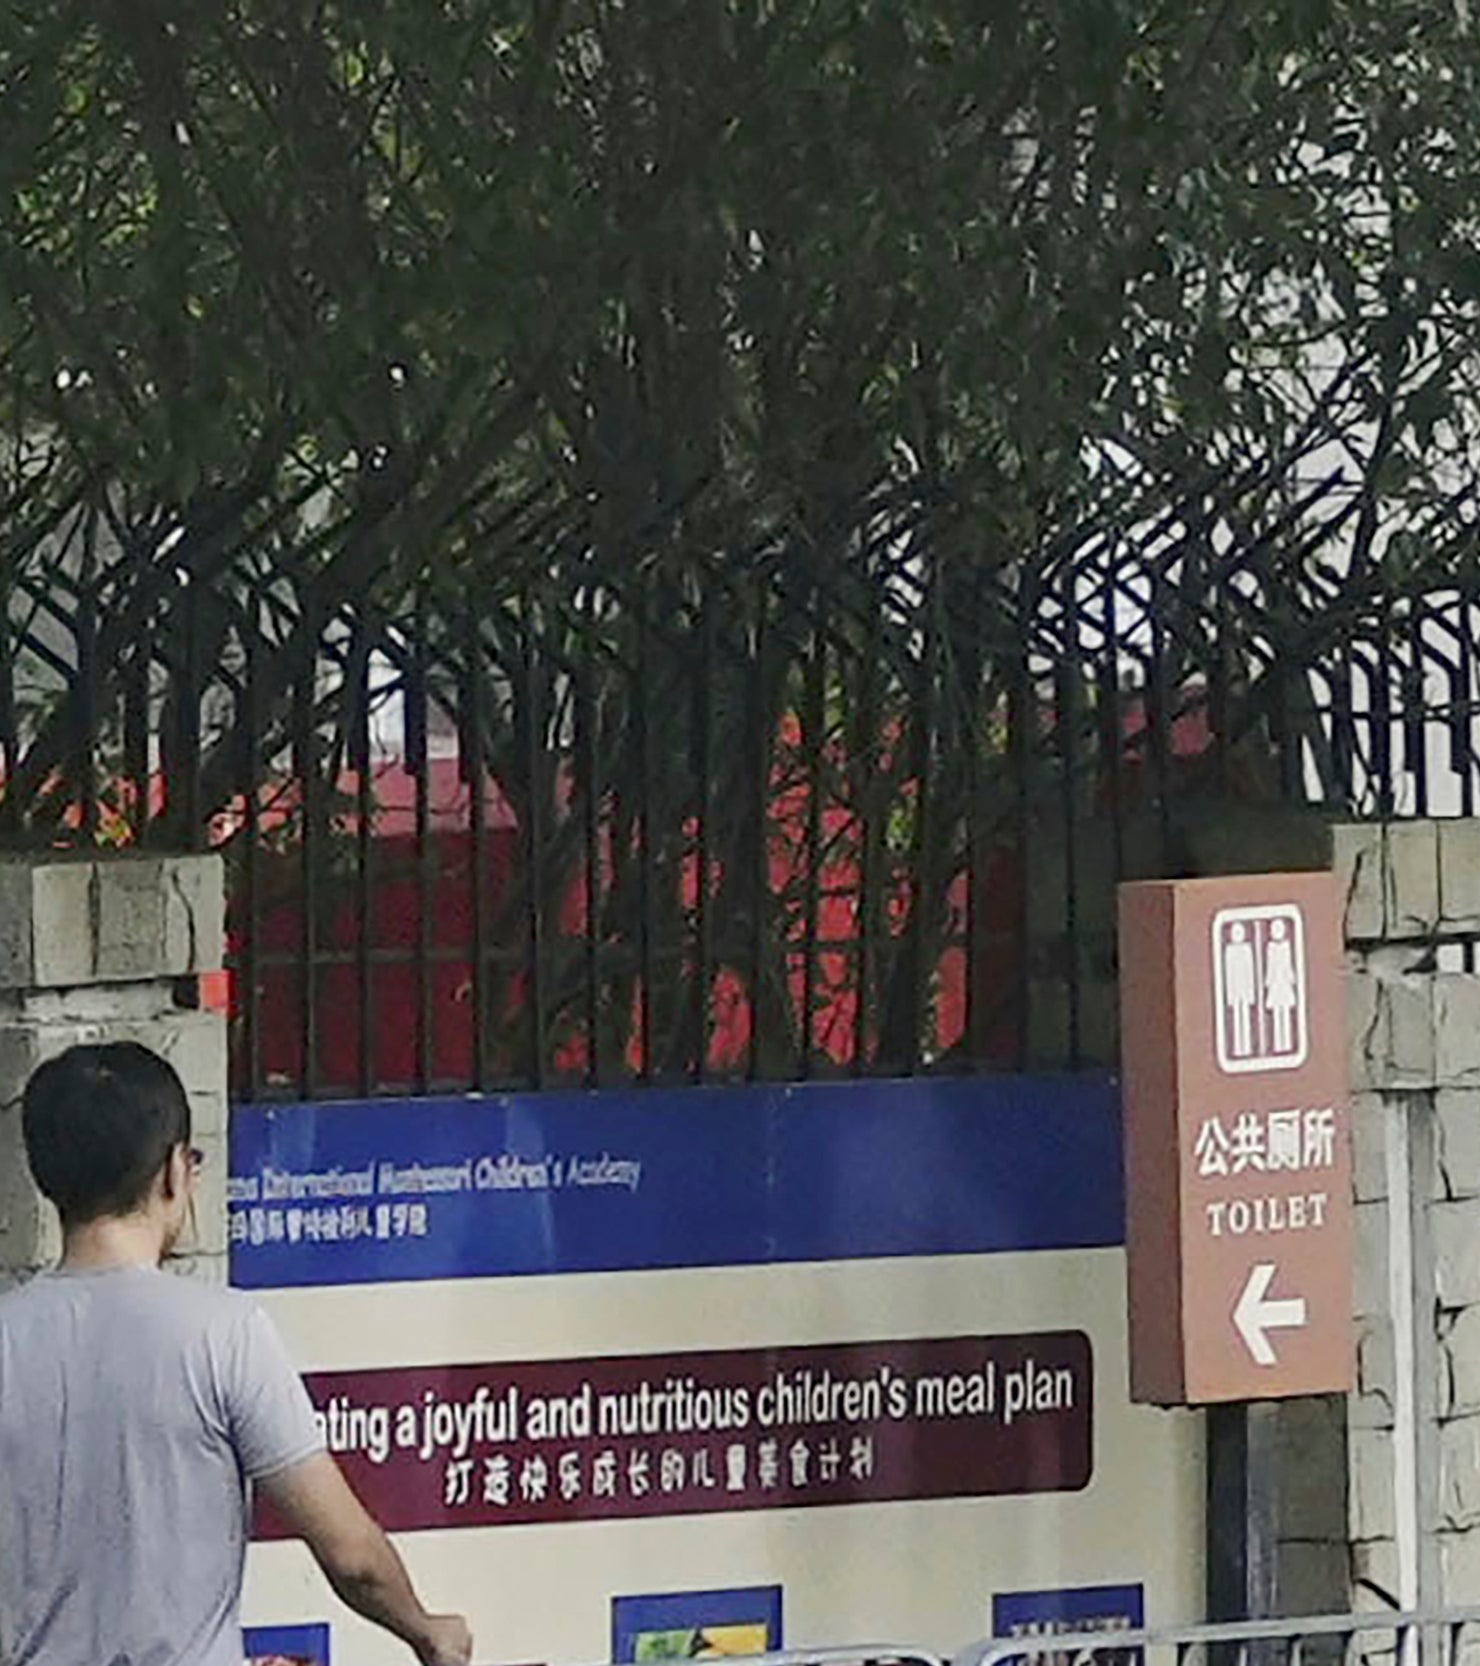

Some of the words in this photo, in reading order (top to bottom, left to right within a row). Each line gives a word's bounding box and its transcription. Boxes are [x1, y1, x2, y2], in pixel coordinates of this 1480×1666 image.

[1195, 1109, 1336, 1177] 公共厕所
[378, 1159, 473, 1195] Montessori
[474, 1154, 564, 1190] Children's
[567, 1153, 641, 1193] Academy
[1206, 1192, 1328, 1237] TOILET
[395, 1404, 416, 1447] a
[419, 1384, 519, 1461] joyful
[525, 1382, 590, 1440] and
[597, 1376, 751, 1435] nutritious
[755, 1365, 908, 1426] children's
[915, 1360, 995, 1417] meal
[1003, 1358, 1074, 1425] plan
